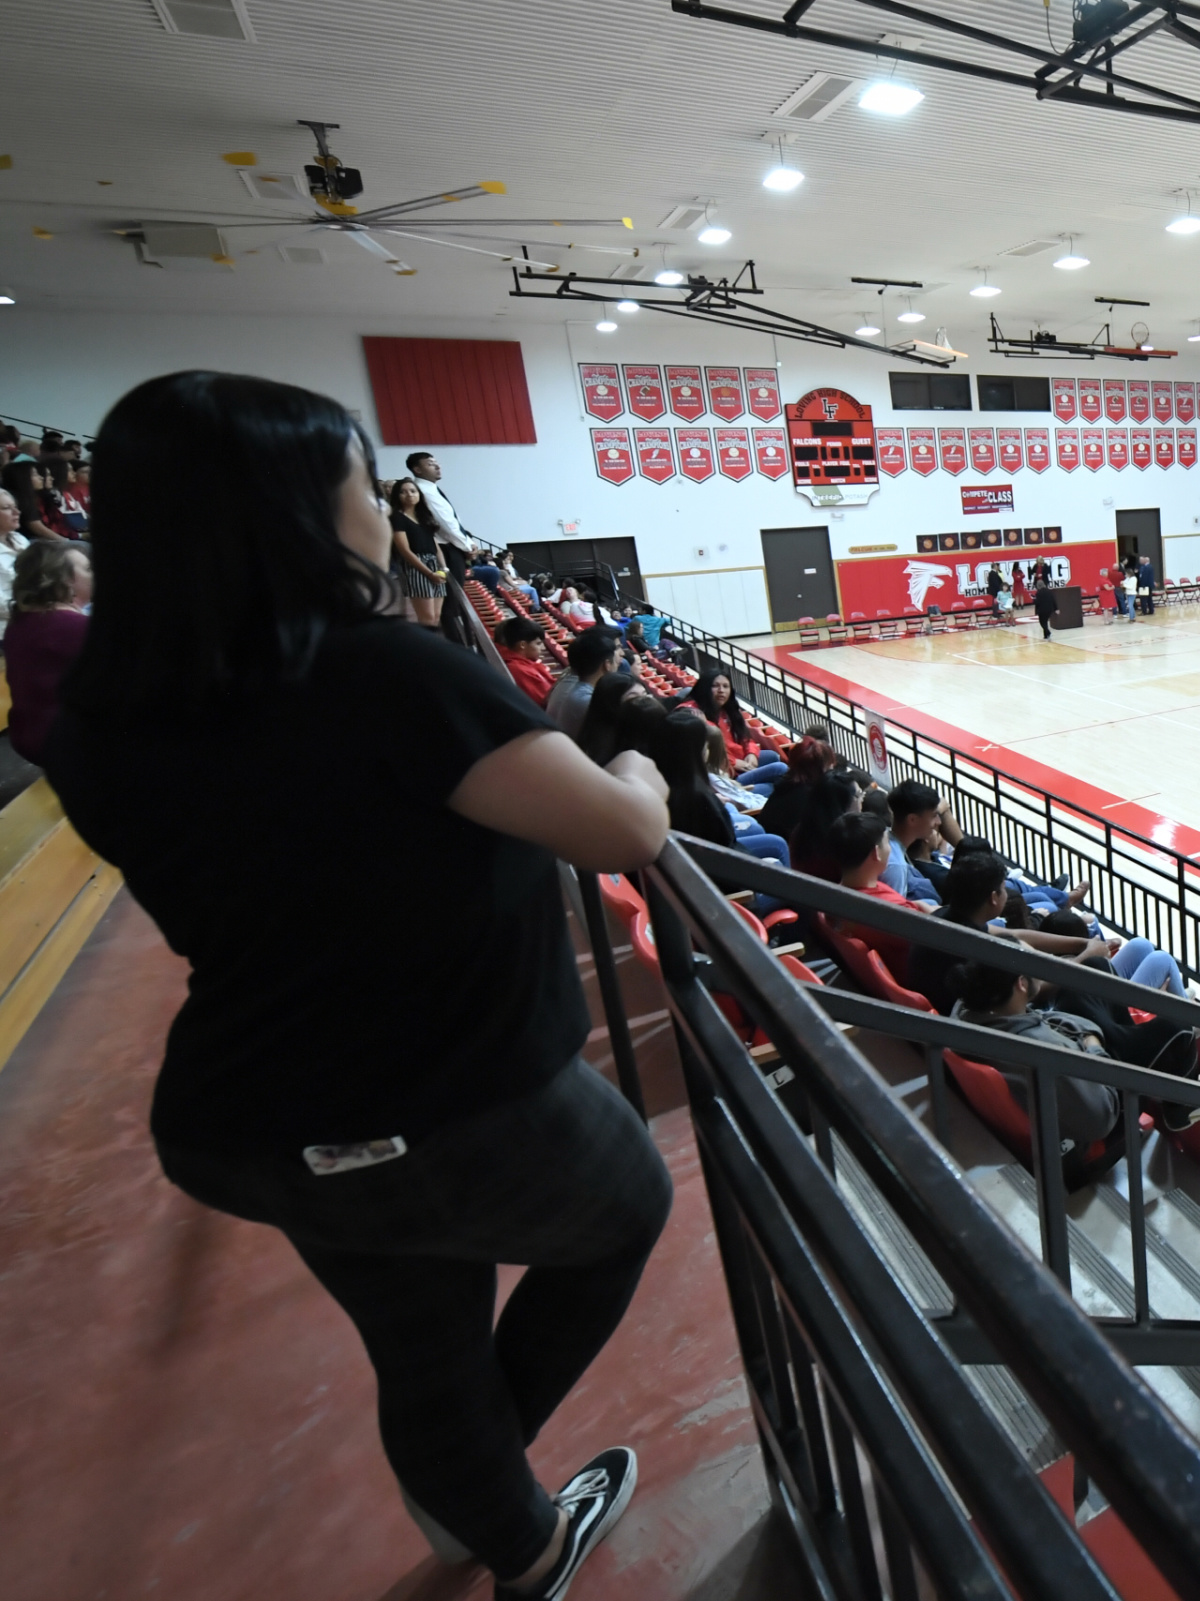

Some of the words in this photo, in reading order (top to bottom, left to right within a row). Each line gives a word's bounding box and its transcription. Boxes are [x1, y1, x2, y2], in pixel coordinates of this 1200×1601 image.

[795, 391, 817, 418] LOVING
[818, 389, 837, 397] HIGH
[839, 391, 866, 419] SCHOOL
[962, 490, 988, 498] COMPETE
[988, 490, 1012, 503] CLASS
